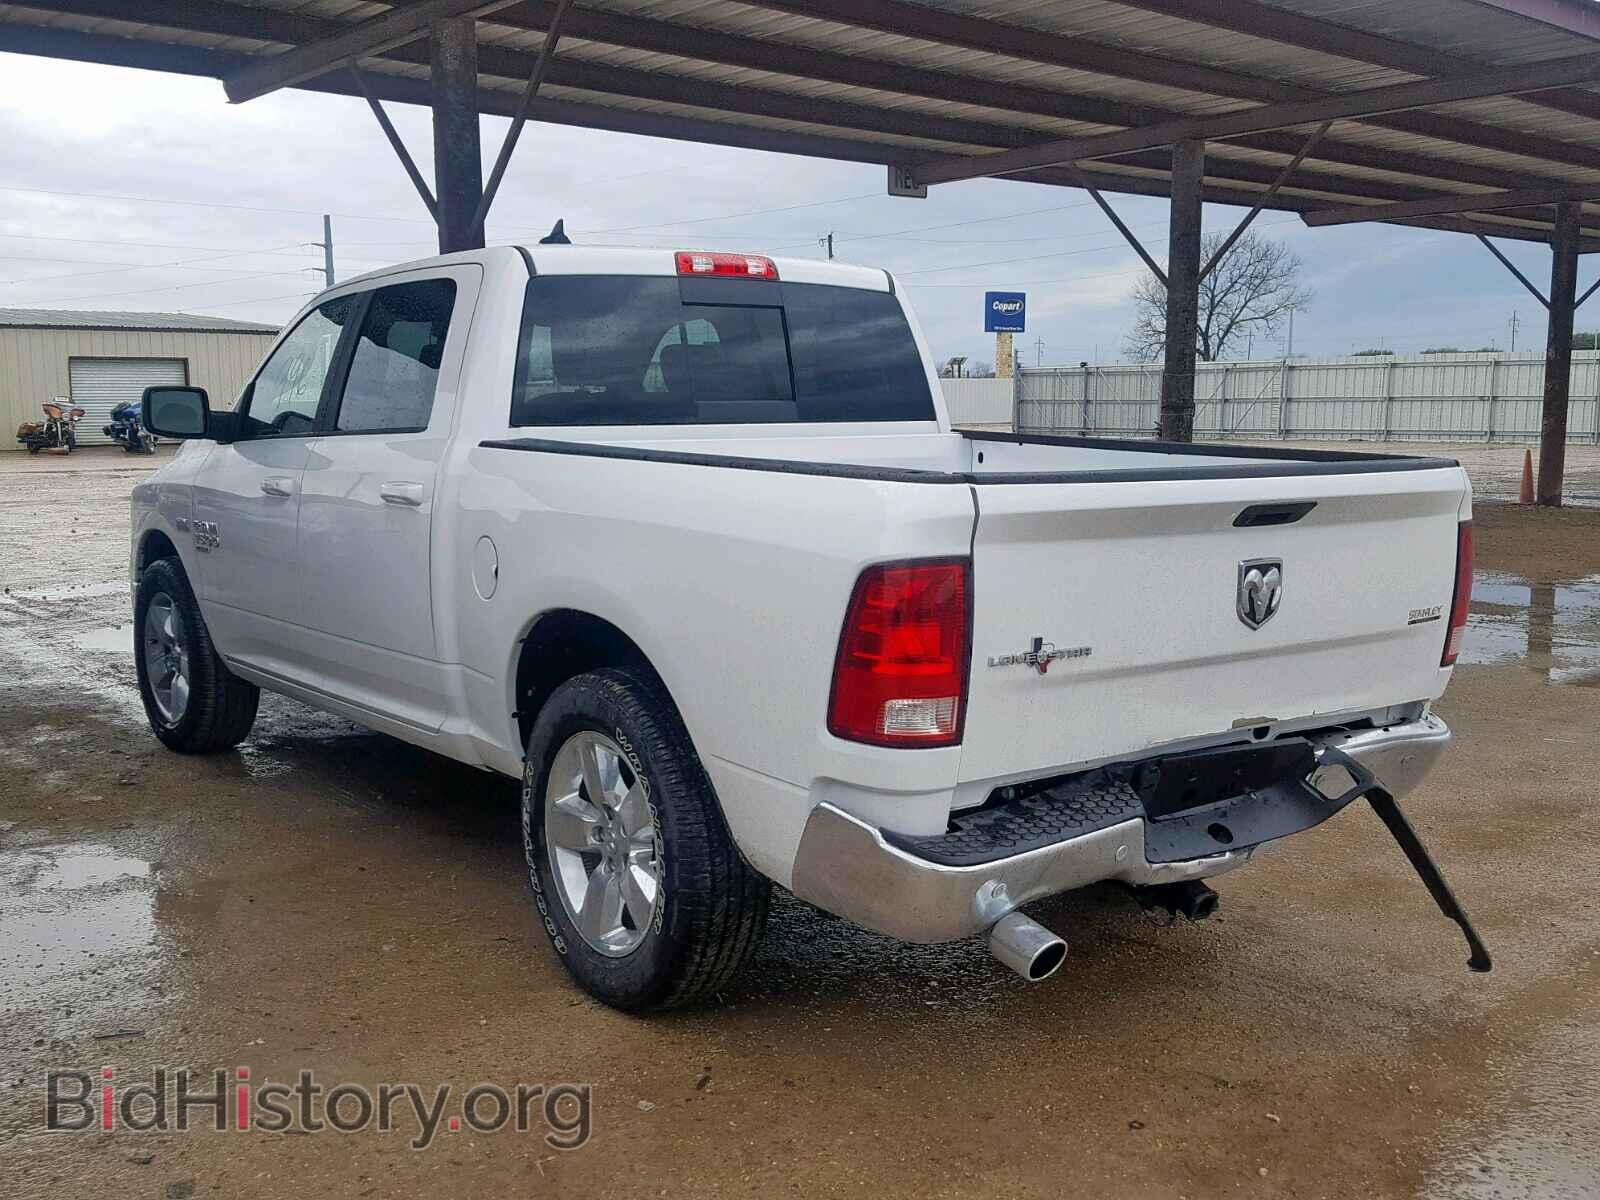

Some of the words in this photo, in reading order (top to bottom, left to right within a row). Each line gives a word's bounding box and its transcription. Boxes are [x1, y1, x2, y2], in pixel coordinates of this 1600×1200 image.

[992, 300, 1021, 312] Copart
[1408, 605, 1443, 620] STANLEY
[987, 652, 1038, 668] LONE
[1047, 646, 1093, 661] STAR
